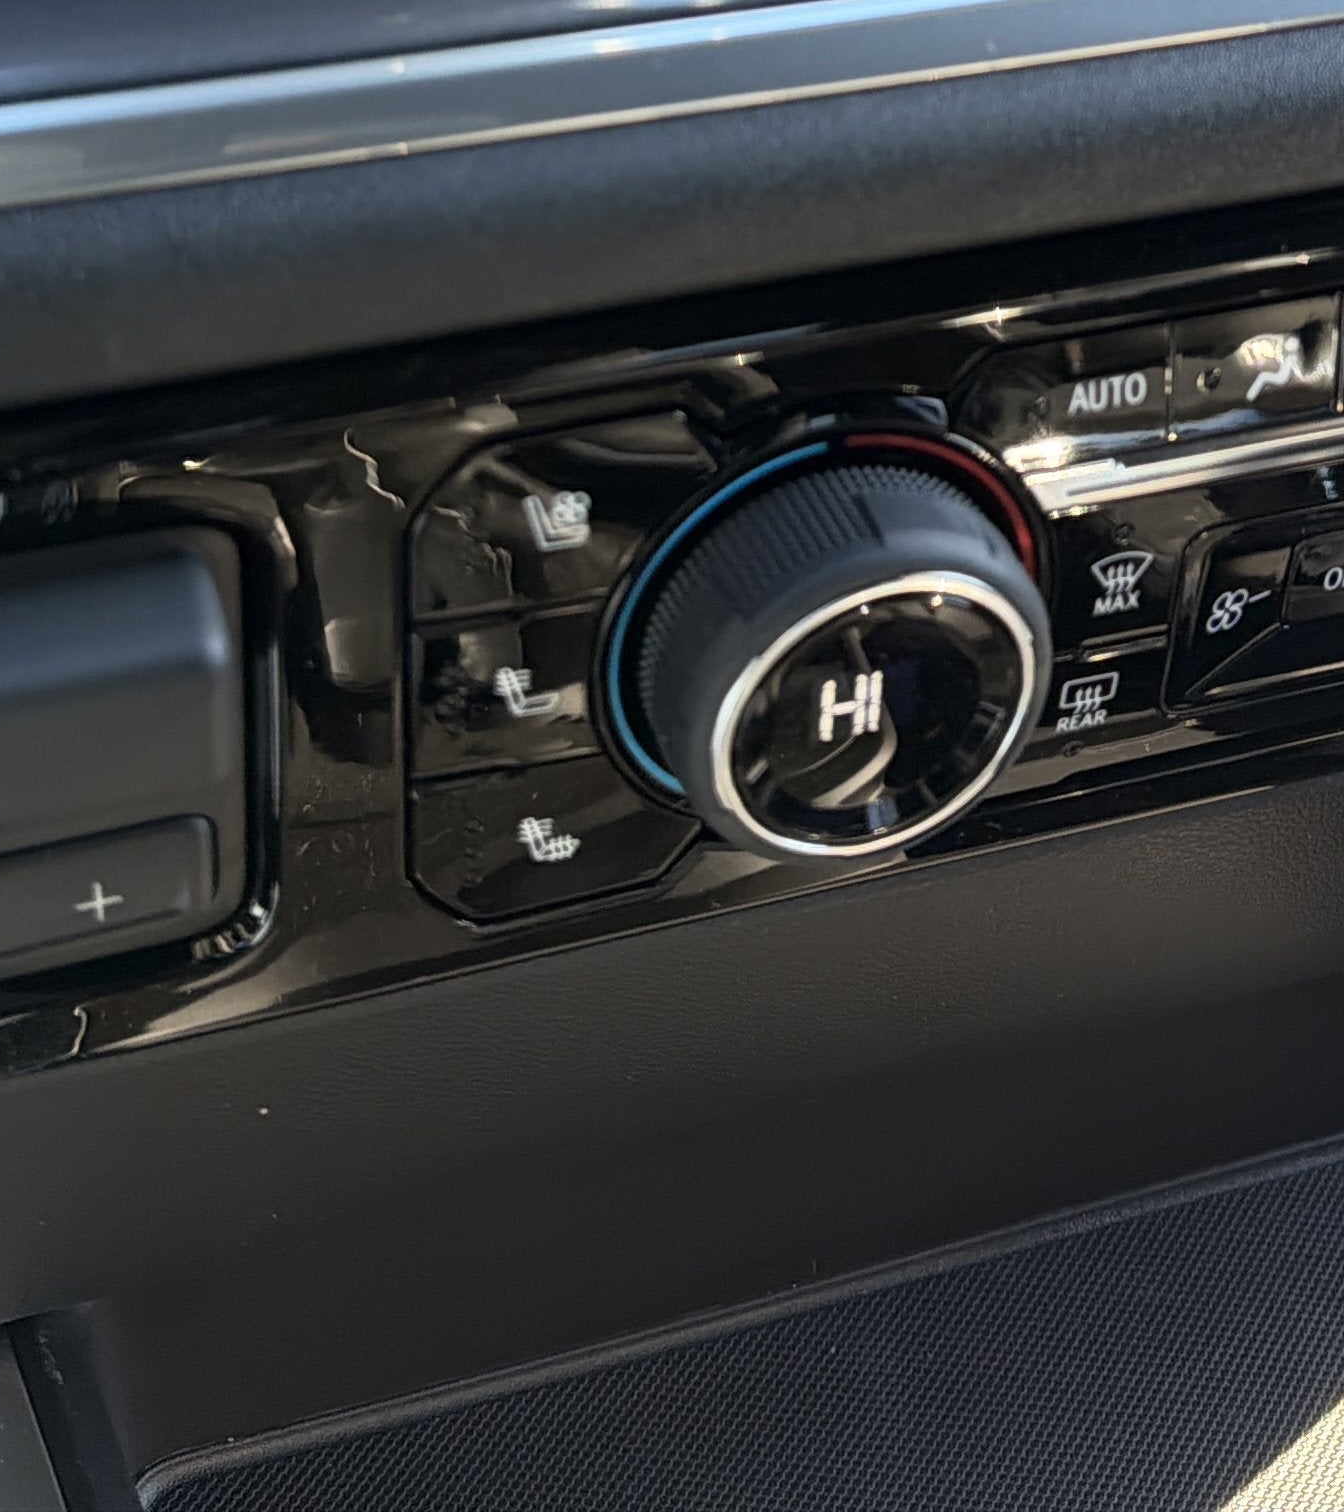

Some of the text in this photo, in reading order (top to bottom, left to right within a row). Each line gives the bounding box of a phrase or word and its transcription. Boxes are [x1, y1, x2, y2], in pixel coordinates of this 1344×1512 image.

[1068, 372, 1147, 417] AUTO
[1092, 589, 1141, 616] MAX
[819, 669, 885, 742] HI
[1056, 710, 1108, 735] REAR
